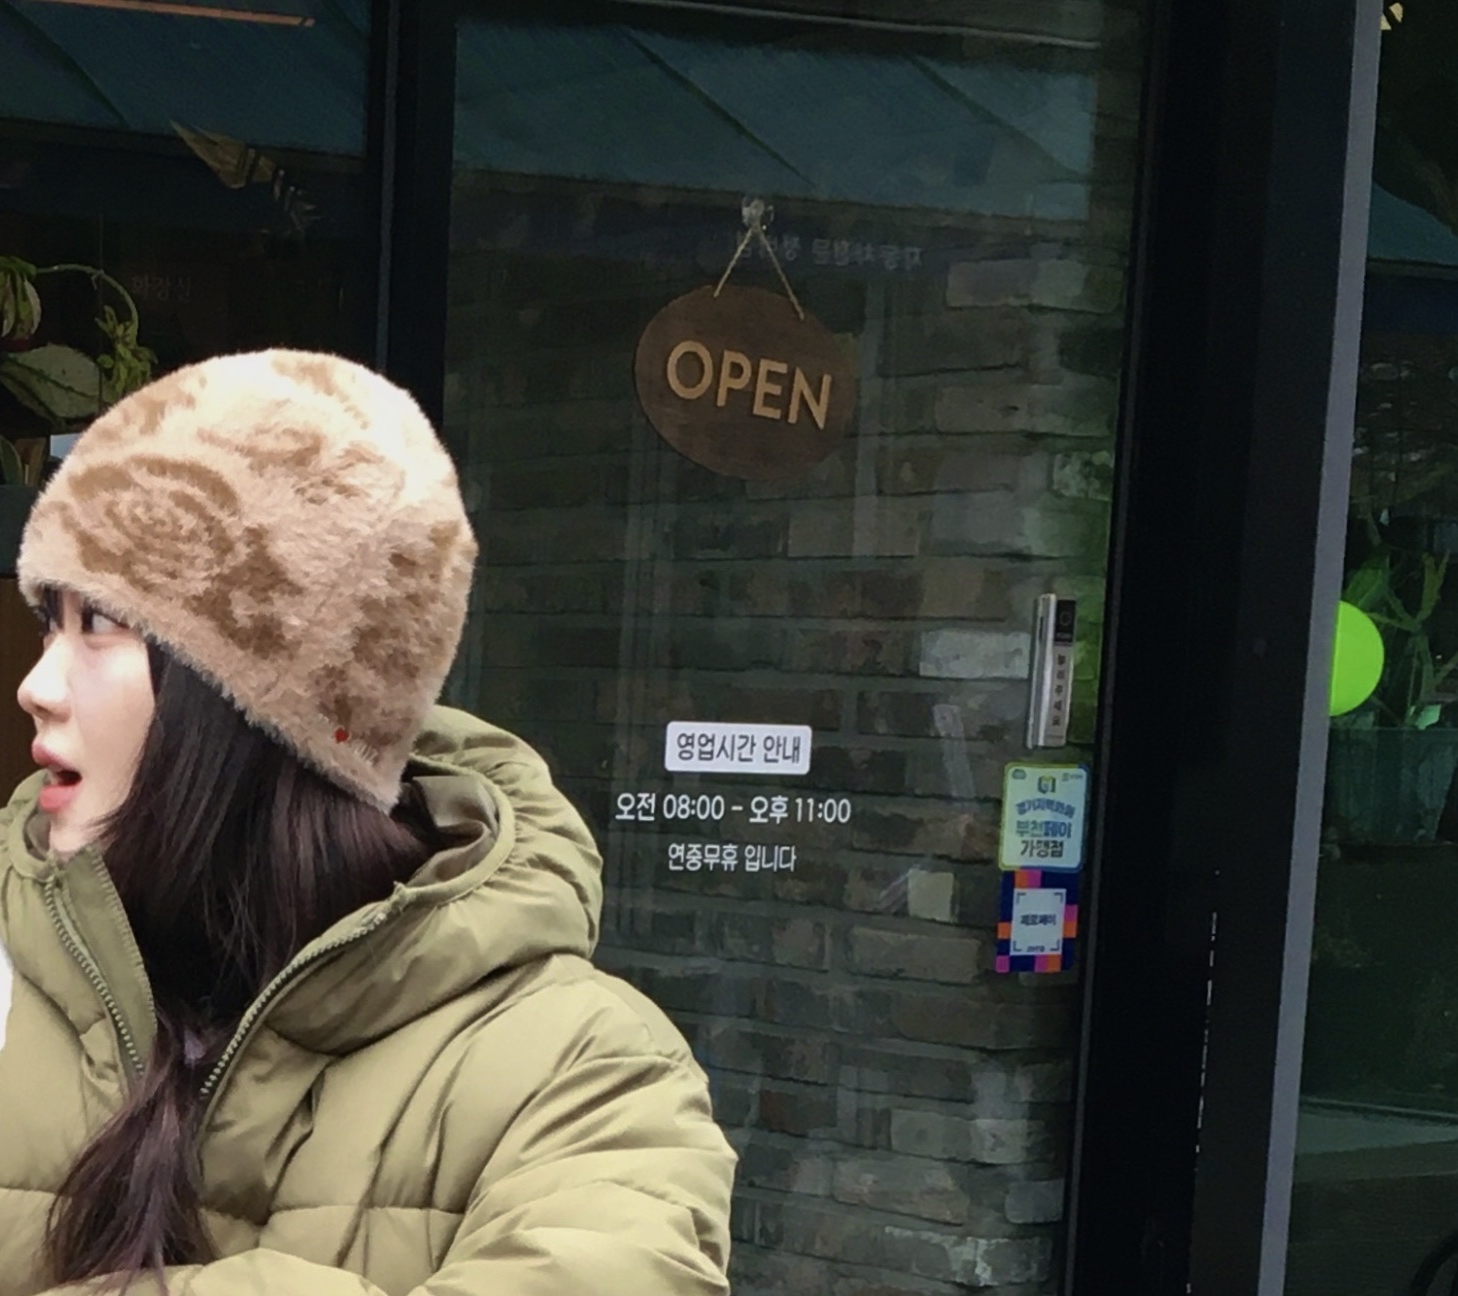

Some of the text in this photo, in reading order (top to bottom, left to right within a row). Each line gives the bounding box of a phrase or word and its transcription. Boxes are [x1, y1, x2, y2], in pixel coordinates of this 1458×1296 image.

[666, 340, 832, 430] OPEN
[677, 732, 801, 764] 영업시간 안내
[615, 792, 656, 822] 오전
[663, 794, 725, 820] 08:00
[749, 795, 788, 824] 오후
[795, 797, 851, 823] 11:00
[1016, 820, 1072, 839] 부천페이
[668, 842, 796, 872] 연중무휴 입니다
[1020, 839, 1064, 858] 가맹점
